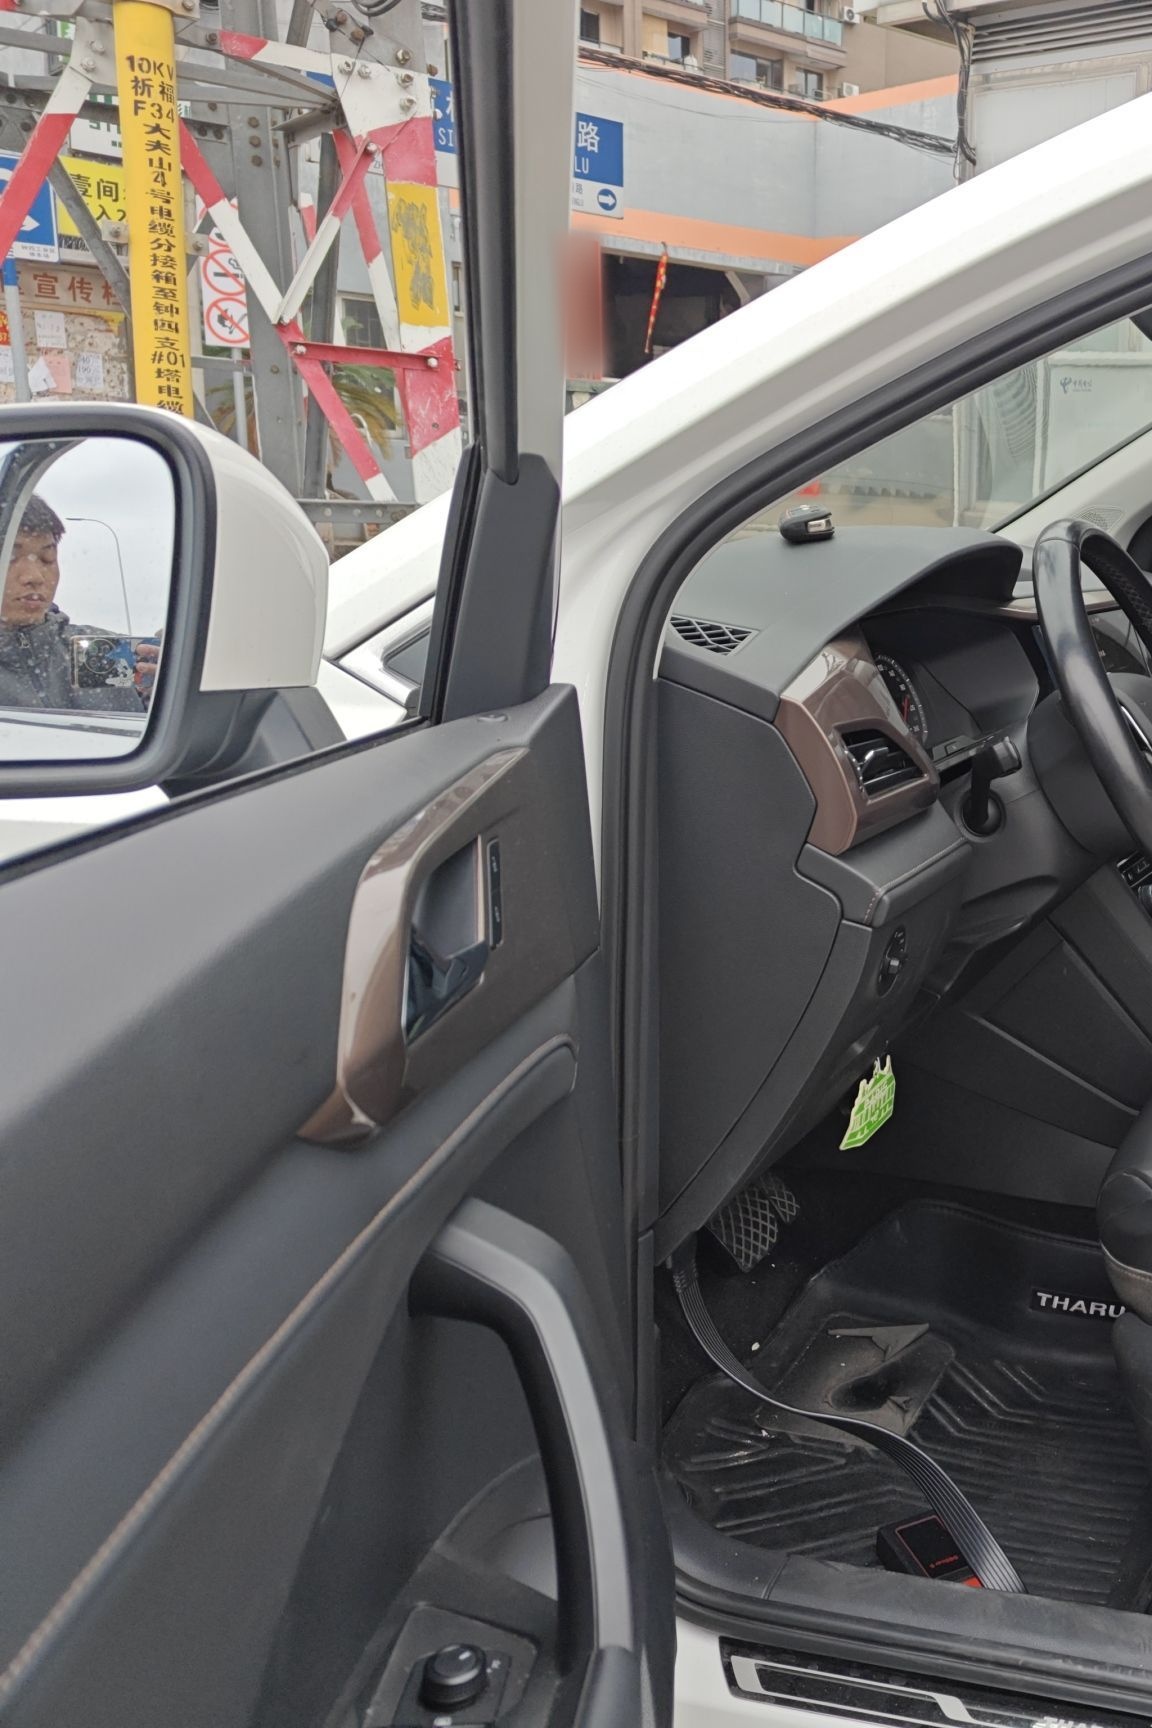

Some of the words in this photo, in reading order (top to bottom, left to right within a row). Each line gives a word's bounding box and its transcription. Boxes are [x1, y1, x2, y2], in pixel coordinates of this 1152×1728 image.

[126, 55, 174, 81] 10KV
[130, 76, 176, 106] 祈福
[134, 100, 175, 123] F34
[577, 120, 600, 153] 路
[574, 155, 589, 174] LU
[1037, 1291, 1126, 1318] THARU
